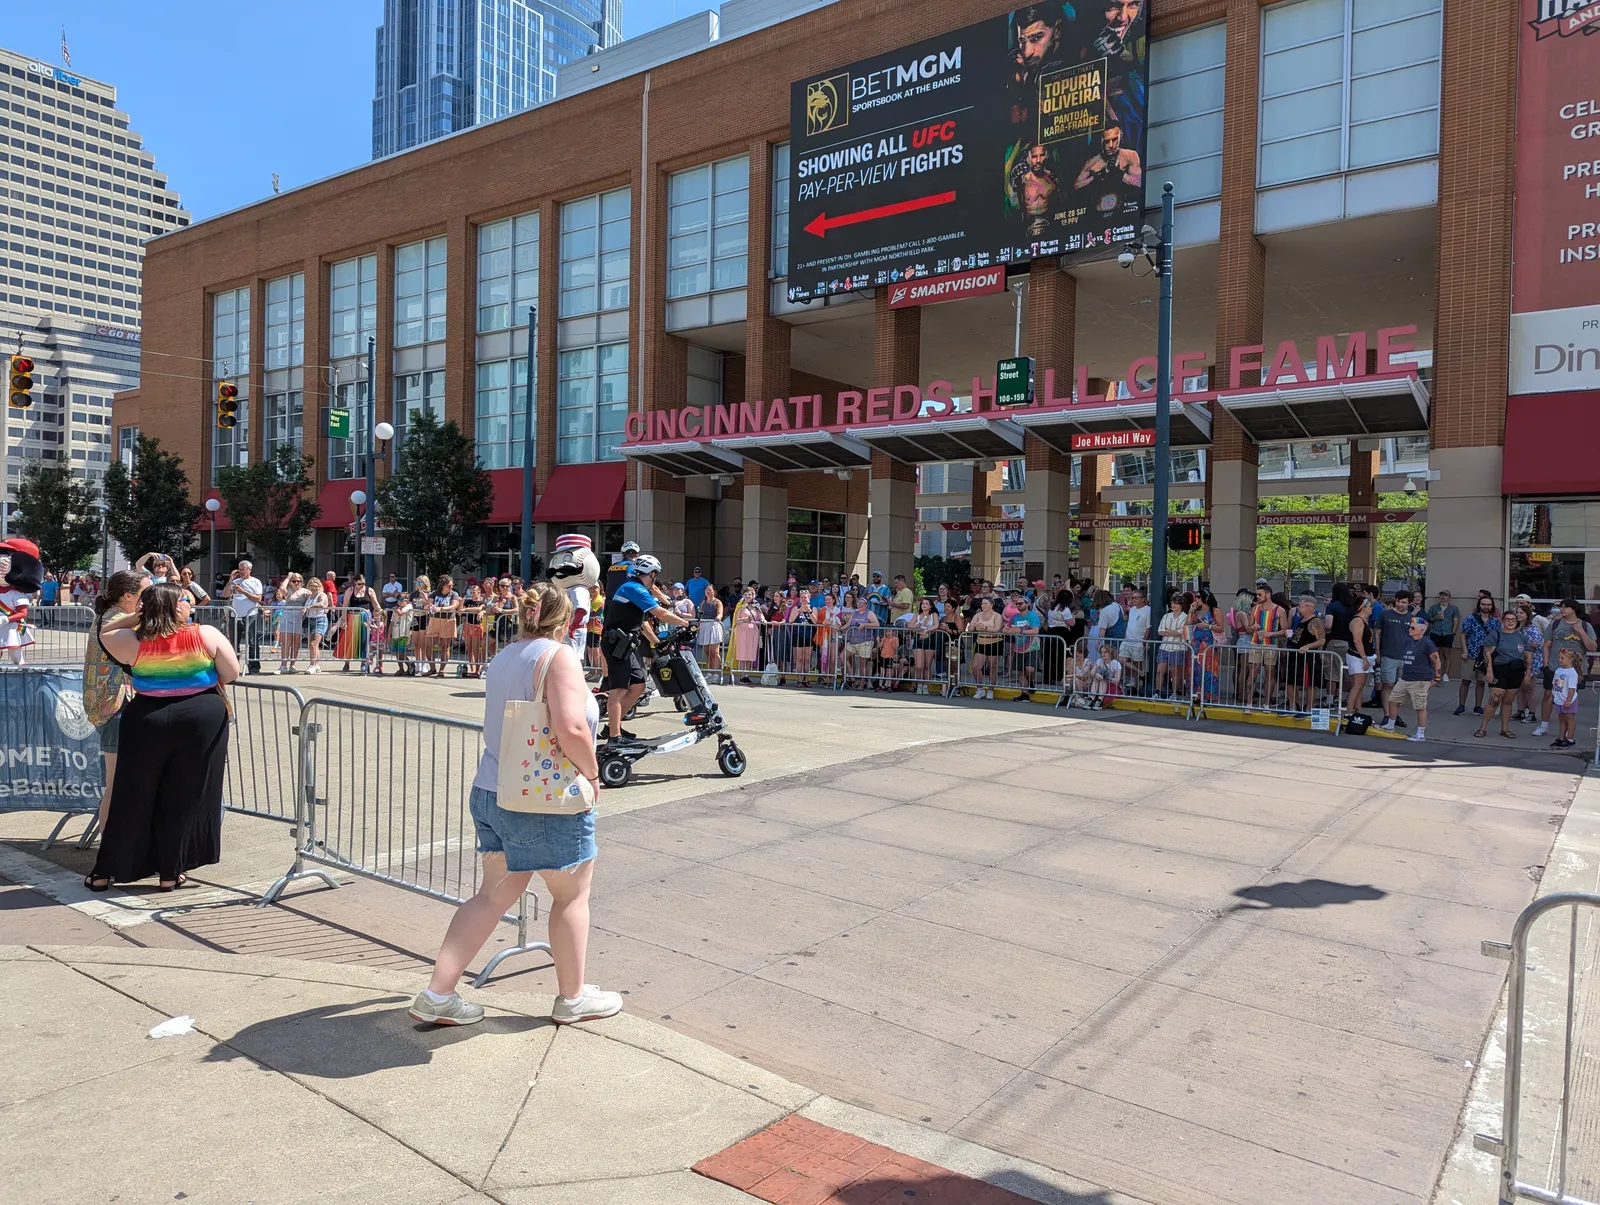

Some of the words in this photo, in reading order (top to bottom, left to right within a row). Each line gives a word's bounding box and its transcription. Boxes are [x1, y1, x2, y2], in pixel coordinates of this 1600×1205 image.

[29, 61, 82, 87] altafiber
[852, 46, 962, 100] BETMGM
[1044, 69, 1101, 98] TOPURIA
[852, 91, 903, 113] SPORTSBOOK
[904, 88, 914, 98] AT
[915, 84, 931, 95] THE
[932, 75, 961, 91] BANKS
[1043, 86, 1101, 114] OLIVEIRA
[1053, 108, 1089, 126] PANTOJA
[1559, 100, 1600, 119] CEL
[1043, 114, 1100, 138] KARA-FRANCE
[1570, 121, 1600, 140] GR
[798, 143, 873, 178] SHOWING
[876, 134, 908, 158] ALL
[911, 121, 956, 148] UFC
[798, 160, 898, 201] PAY-PER-VIEW
[901, 144, 963, 177] FIGHTS
[1563, 160, 1600, 180] PRE
[1585, 182, 1600, 199] H
[1053, 211, 1067, 220] JUNE
[1076, 207, 1087, 216] SAT
[1067, 216, 1079, 225] PPV
[1568, 222, 1600, 240] PR
[817, 257, 837, 266] PRESENT
[853, 248, 881, 259] GAMBLING
[880, 242, 908, 254] PROBLEM?
[908, 240, 921, 248] CALL
[922, 231, 966, 245] 1-800-GAMBLER.
[1560, 244, 1600, 263] INS
[827, 261, 859, 272] PARTNERSHIP
[859, 257, 873, 265] WITH
[873, 255, 888, 263] MGM
[888, 248, 920, 260] NORTHFIELD
[920, 246, 935, 254] PARK.
[910, 273, 998, 299] SMARTVISION
[1582, 319, 1600, 330] PR
[108, 329, 125, 338] GO
[126, 332, 141, 341] RE
[1000, 362, 1017, 371] Main
[1534, 342, 1600, 375] Din
[624, 393, 823, 443] CINCINNATI
[836, 379, 956, 425] REDS
[971, 364, 1106, 413] HLL
[1229, 324, 1419, 389] FAME
[999, 370, 1019, 380] Street
[998, 393, 1025, 403] 100-159
[330, 409, 349, 417] Freedom
[330, 420, 340, 428] East
[1075, 436, 1091, 448] Joe
[1094, 433, 1129, 446] Nuxhall
[1132, 432, 1151, 444] Way
[971, 522, 1007, 530] WELCOME
[1074, 520, 1091, 528] THE
[1092, 519, 1140, 527] CINCINNATI
[1141, 519, 1153, 527] RE
[1175, 517, 1211, 526] BASEBA
[1258, 515, 1334, 525] PROFESSIONAL
[1335, 514, 1367, 523] TEAM
[1188, 528, 1199, 545] 11
[59, 747, 88, 771] TO
